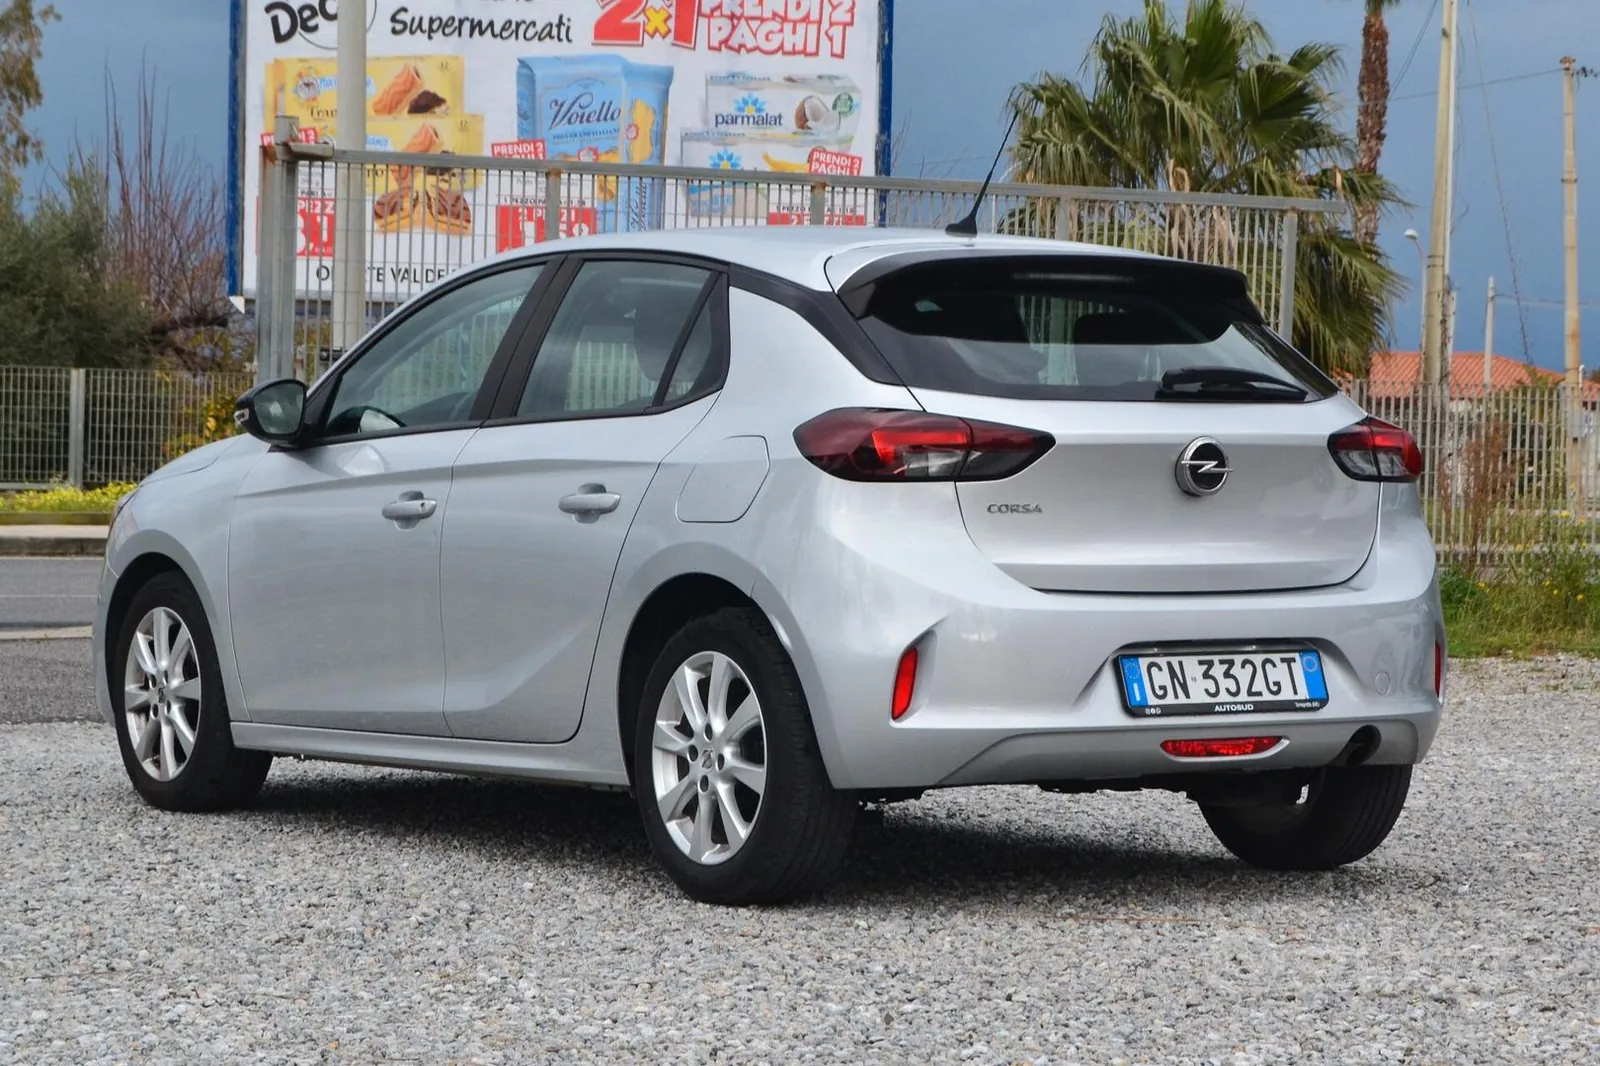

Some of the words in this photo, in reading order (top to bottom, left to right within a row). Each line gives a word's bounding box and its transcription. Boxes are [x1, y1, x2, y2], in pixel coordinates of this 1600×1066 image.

[264, 0, 338, 44] Dec
[390, 7, 572, 42] Supermercati
[708, 16, 822, 58] PAGHI
[825, 25, 853, 59] 1
[549, 92, 622, 131] Voiello
[714, 112, 783, 128] parmalat
[493, 142, 534, 155] PRENDI
[811, 161, 849, 175] PAGHI
[813, 152, 851, 165] PRENDI
[853, 158, 860, 168] 2
[987, 503, 1043, 514] CORSA
[1146, 660, 1191, 700] GN
[1197, 657, 1298, 698] 332GT
[1214, 704, 1254, 713] AUTOSUD
